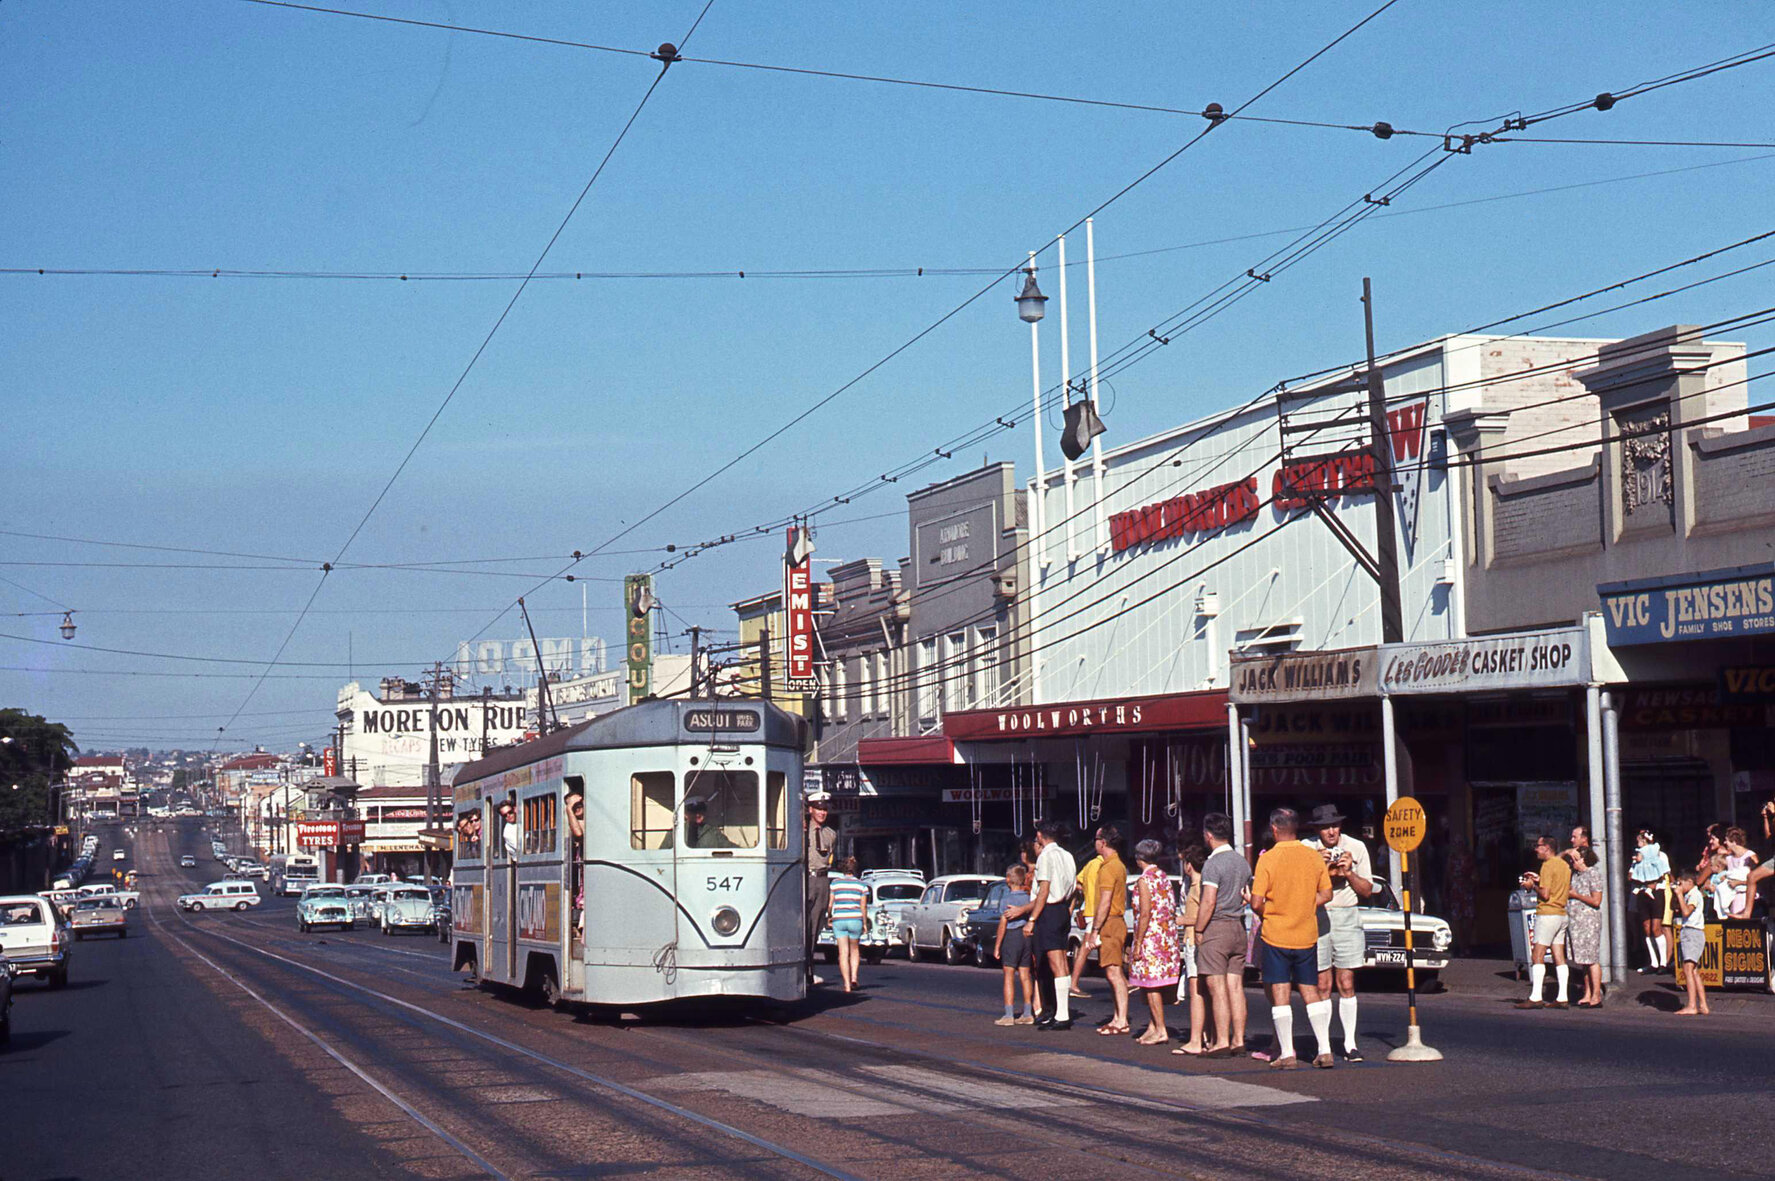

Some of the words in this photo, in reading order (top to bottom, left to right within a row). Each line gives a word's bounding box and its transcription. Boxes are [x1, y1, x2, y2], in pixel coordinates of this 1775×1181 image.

[1387, 402, 1425, 461] W
[1108, 477, 1260, 551] WOOLWORTHS
[791, 560, 809, 672] EMIST
[1608, 594, 1650, 628] VIC
[1660, 579, 1774, 638] JENSENS
[1678, 624, 1705, 635] FAMILY
[1712, 621, 1734, 632] SHOE
[1743, 617, 1775, 630] STORES
[1472, 649, 1525, 675] CASKET
[1530, 643, 1572, 671] SHOP
[788, 679, 816, 692] OPEN
[1239, 666, 1276, 693] JACK
[1284, 659, 1361, 691] WILLIAMS
[690, 713, 731, 728] ASCOT
[998, 705, 1142, 731] WOOLWORTHS
[439, 738, 457, 752] EW
[298, 824, 337, 834] Firestone
[1386, 812, 1422, 830] SAFETY
[302, 836, 334, 845] TYRES
[1389, 825, 1416, 839] ZONE
[706, 877, 744, 891] 547
[1726, 928, 1762, 948] NEON
[1724, 952, 1765, 973] SIGNS
